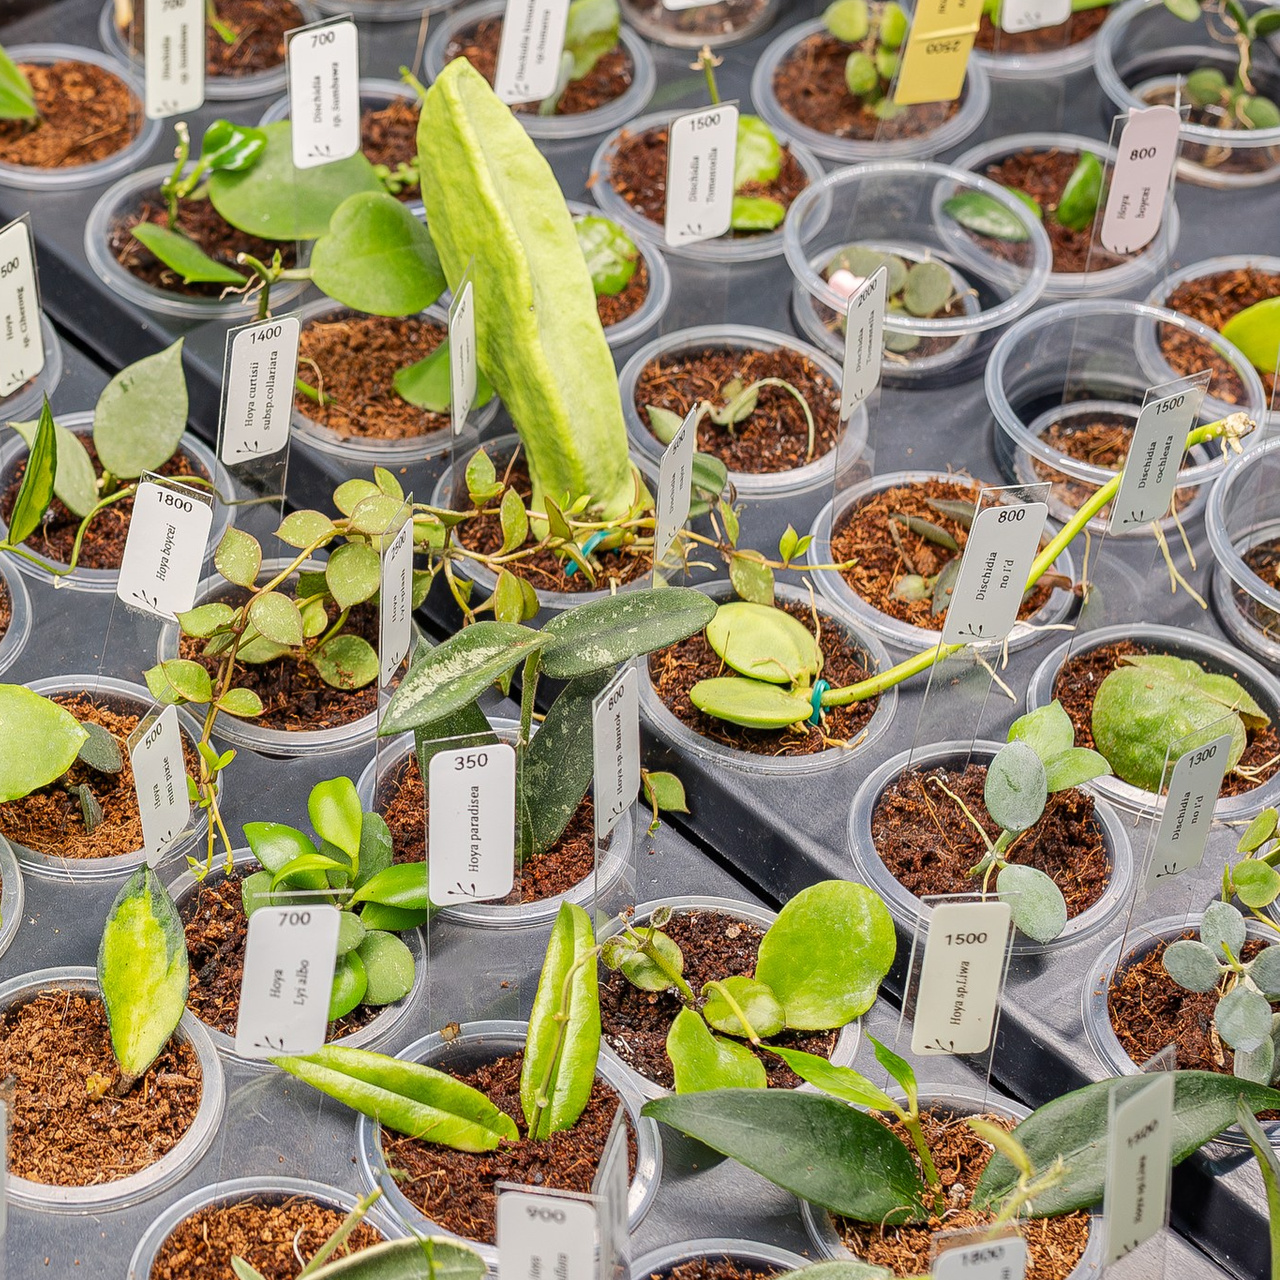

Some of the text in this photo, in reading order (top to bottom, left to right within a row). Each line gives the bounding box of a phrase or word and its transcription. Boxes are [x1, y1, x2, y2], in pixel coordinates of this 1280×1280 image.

[310, 30, 336, 48] 700
[312, 75, 322, 123] Dischidia
[330, 62, 340, 111] Sumbawa
[689, 113, 721, 132] 1500
[1129, 146, 1157, 161] 800
[688, 155, 700, 202] Dischidia
[1117, 195, 1130, 219] Hoya
[857, 278, 878, 308] 2000
[16, 286, 27, 333] Ciherong
[250, 325, 282, 344] 1400
[866, 310, 875, 365] Tomentella
[856, 327, 864, 373] Dischidia
[244, 362, 259, 426] Hoya curtisii
[262, 351, 278, 430] subsp.collariata
[1150, 394, 1185, 415] 1500
[1138, 441, 1157, 489] Dischidia
[1156, 435, 1174, 484] cochleata
[157, 491, 193, 513] 1800
[998, 508, 1026, 524] 800
[156, 523, 176, 582] Hoya boycei
[975, 552, 998, 600] Dischidia
[1000, 575, 1010, 588] no
[145, 722, 162, 750] 500
[614, 712, 622, 752] Buntok
[454, 753, 488, 771] 350
[1188, 742, 1217, 768] 1300
[163, 756, 175, 806] mini pixie
[614, 767, 624, 796] Hoya
[153, 783, 162, 810] Hoya
[467, 786, 482, 872] Hoya paradisea
[1172, 792, 1191, 840] Dischidia
[1191, 810, 1200, 824] no
[280, 911, 311, 926] 700
[946, 932, 988, 946] 1500
[270, 969, 284, 998] Hoya
[296, 960, 309, 985] albo
[950, 961, 970, 1025] Hoya sp.Liwa
[526, 1207, 566, 1222] 900
